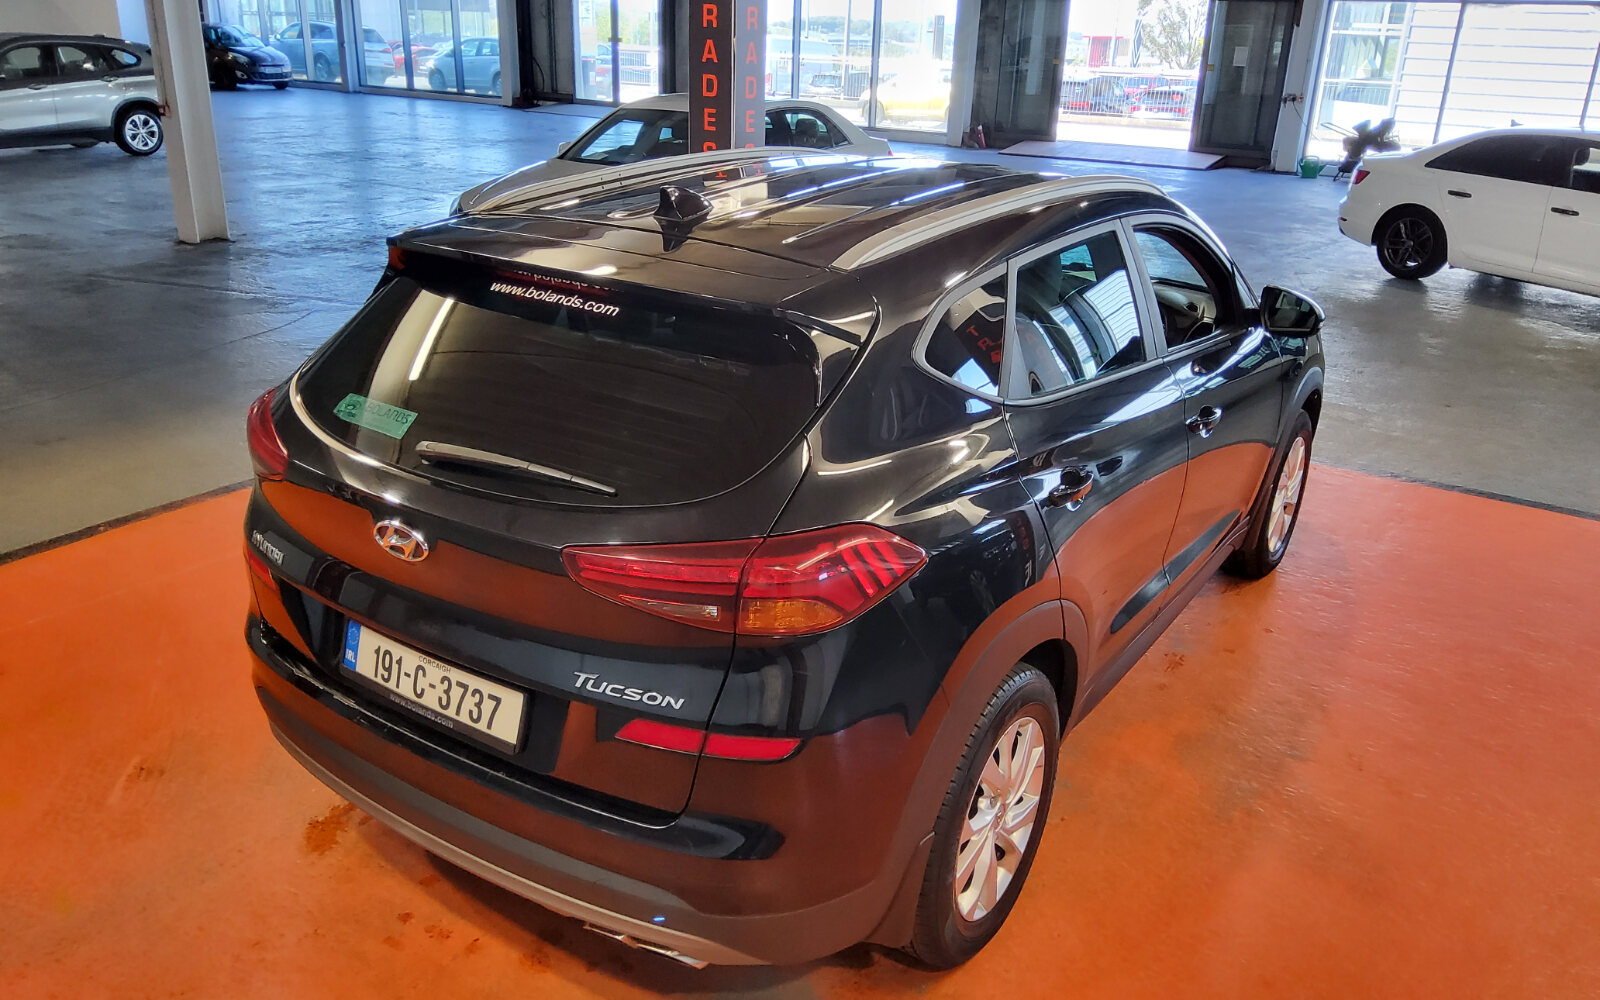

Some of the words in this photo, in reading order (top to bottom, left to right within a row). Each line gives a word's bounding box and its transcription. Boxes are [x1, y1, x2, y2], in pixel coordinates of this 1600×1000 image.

[745, 6, 758, 149] RADE
[489, 281, 620, 317] www.bolands.com
[345, 649, 356, 663] IRL
[418, 655, 451, 673] CORCAIGH
[373, 645, 502, 730] 191-C-3737
[573, 671, 685, 710] TUCSON
[389, 693, 454, 729] www.bolands.com
